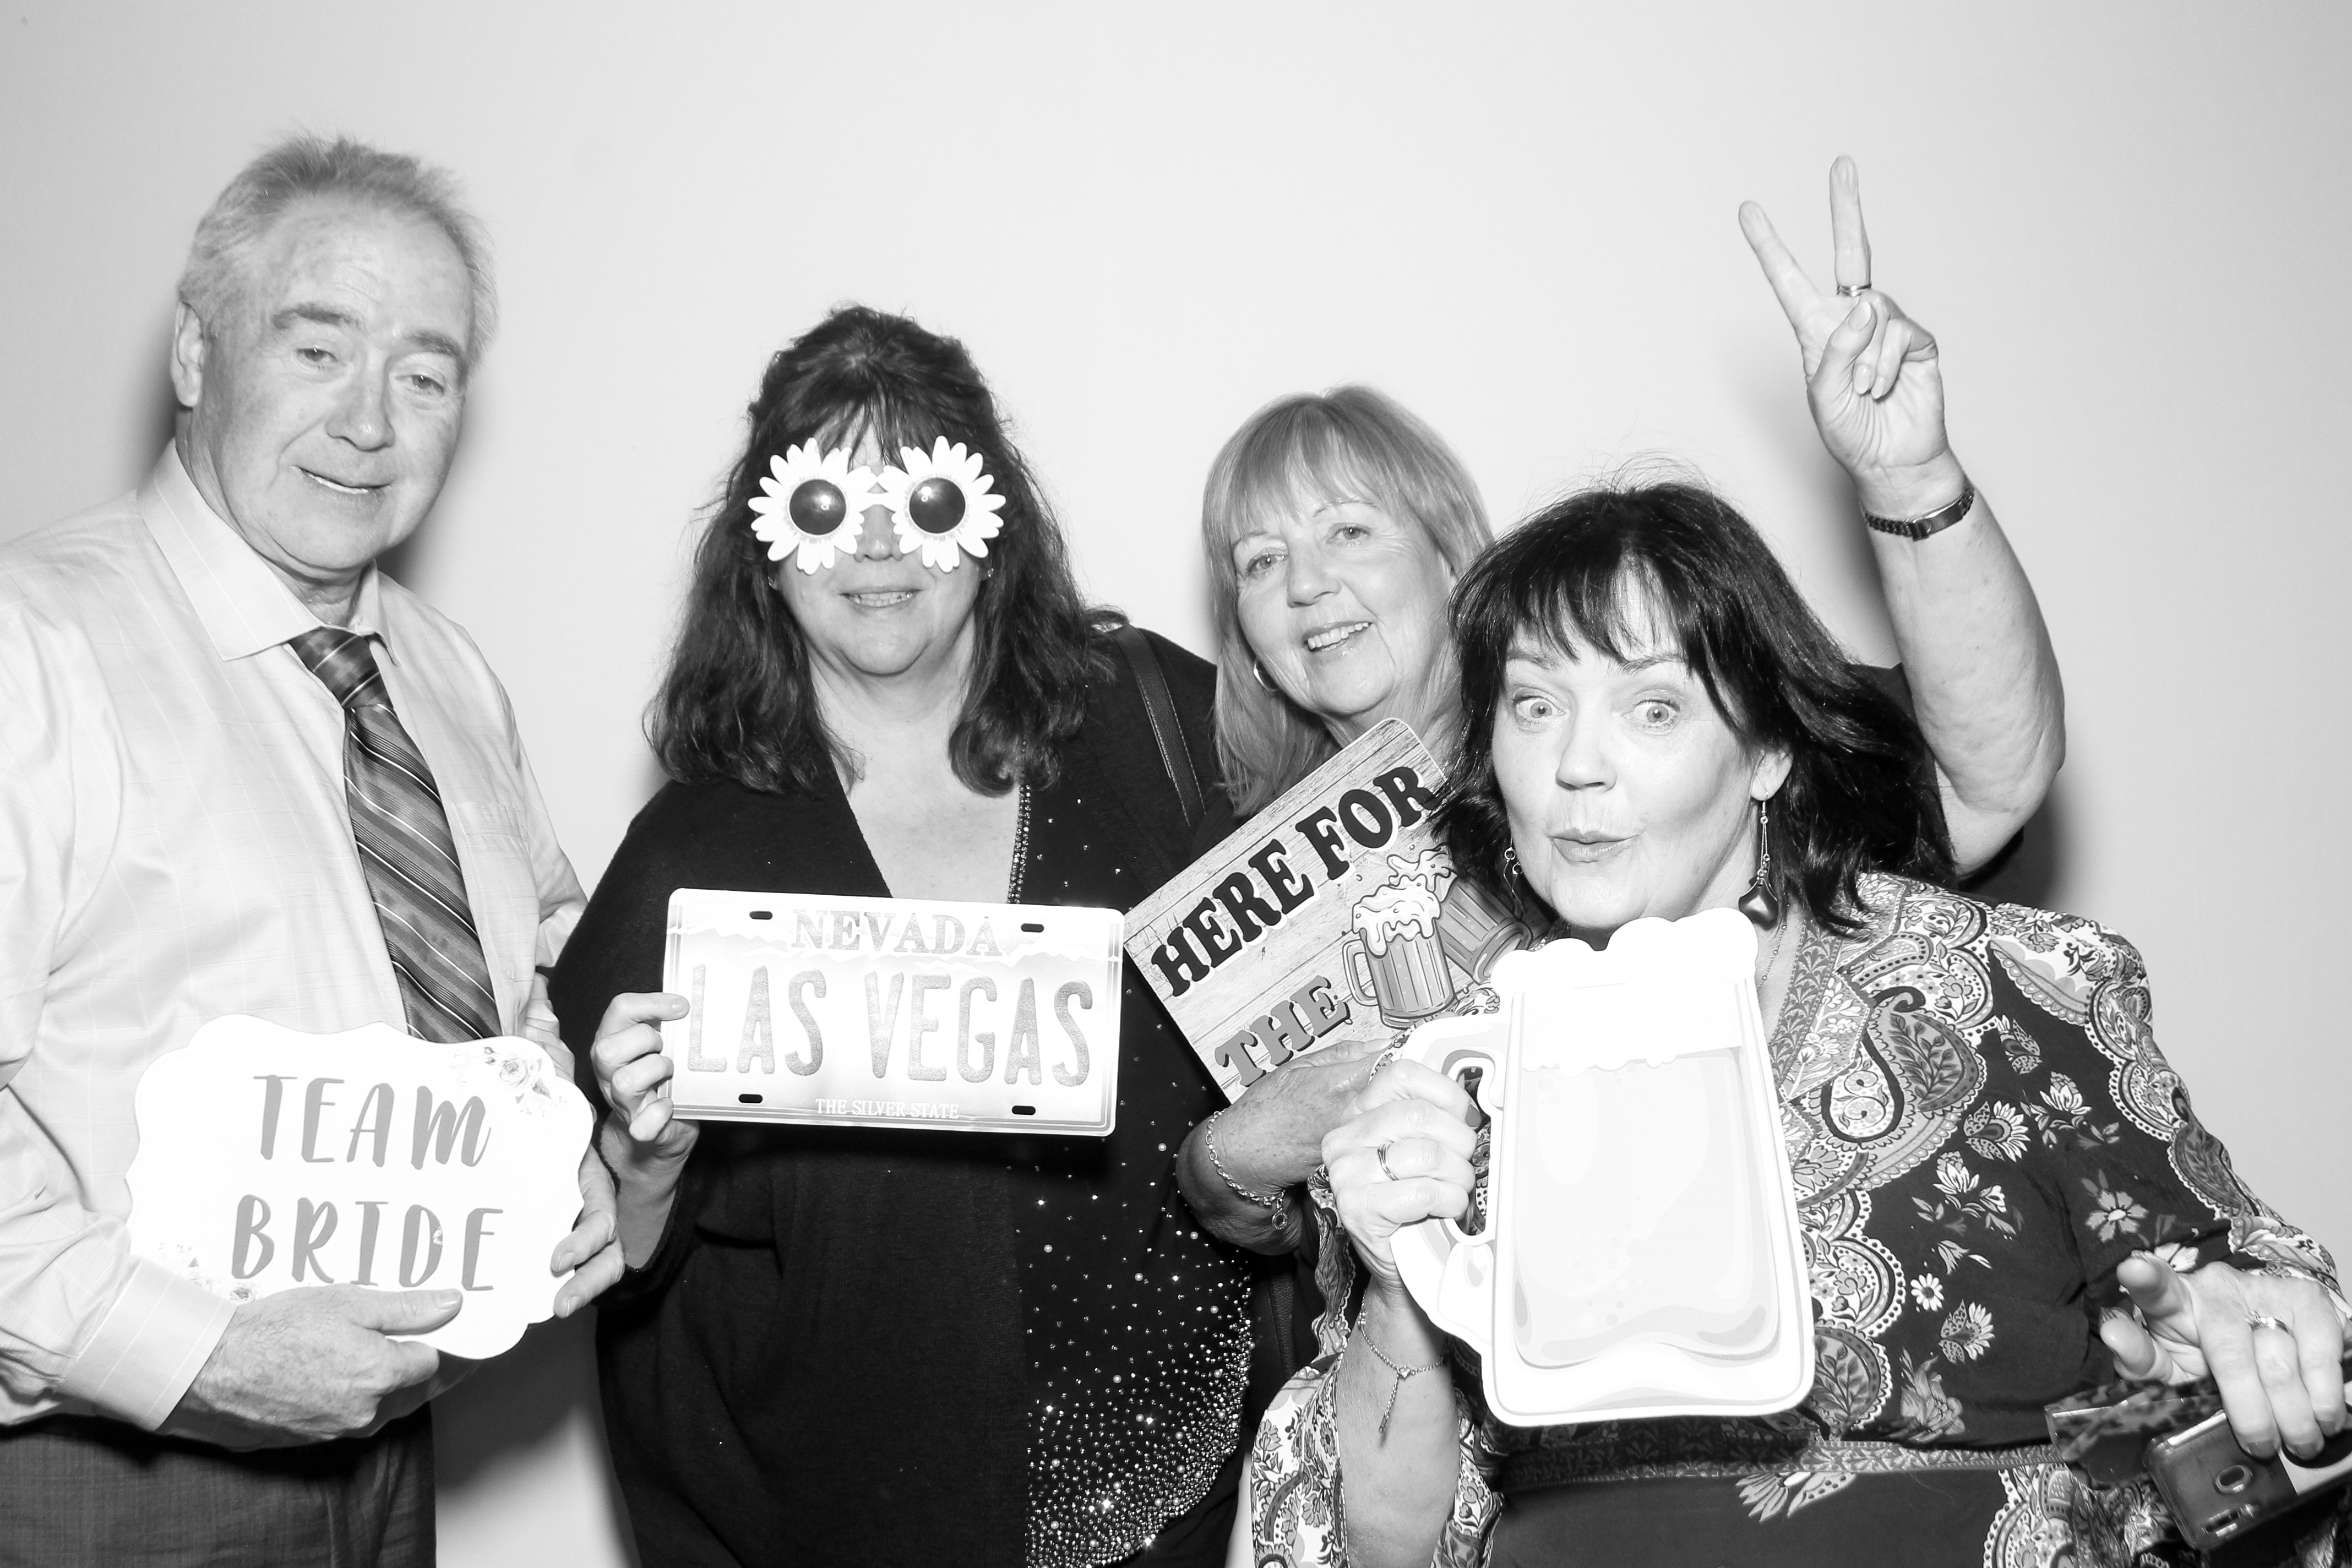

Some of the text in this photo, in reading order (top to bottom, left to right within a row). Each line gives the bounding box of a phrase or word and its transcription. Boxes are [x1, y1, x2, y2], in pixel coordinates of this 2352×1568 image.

[1151, 766, 1437, 998] HERE FOR
[790, 908, 1003, 957] NEVADA
[687, 962, 1093, 1087] LAS VEGAS
[1214, 975, 1351, 1088] THE
[253, 1074, 492, 1170] TEAM
[815, 1098, 960, 1119] THE SILVER STATE
[231, 1194, 504, 1291] BRIDE
